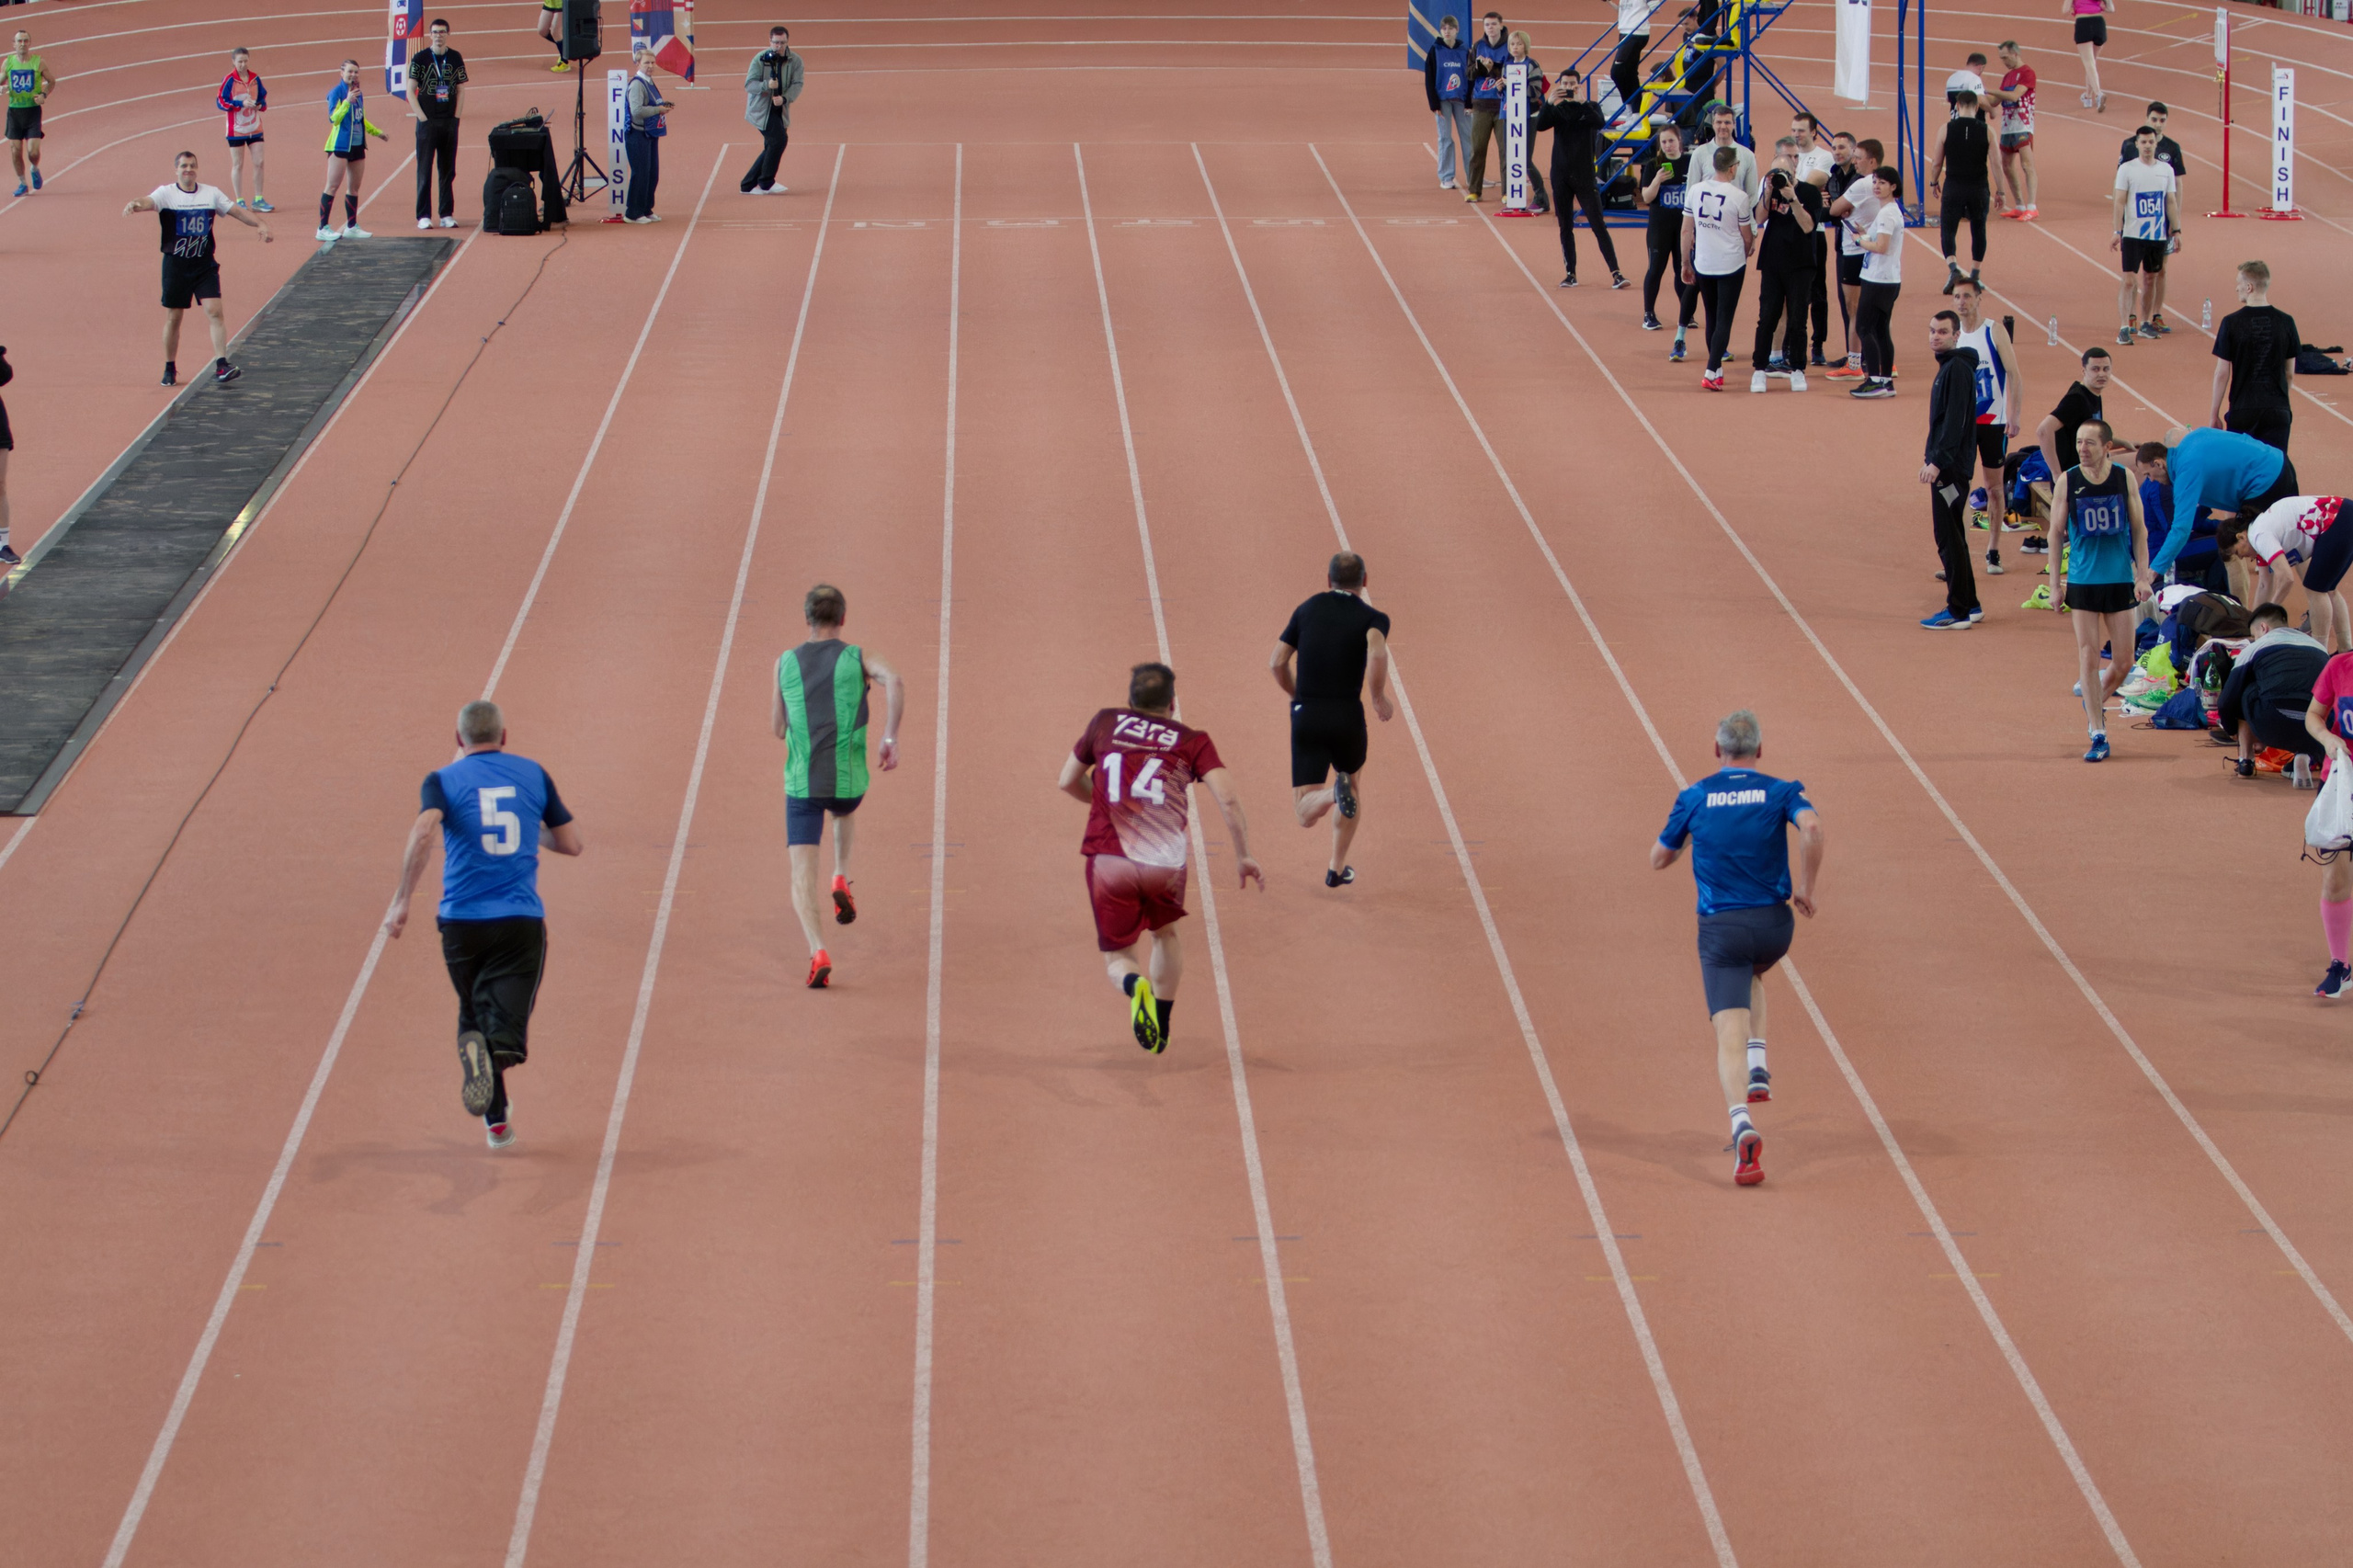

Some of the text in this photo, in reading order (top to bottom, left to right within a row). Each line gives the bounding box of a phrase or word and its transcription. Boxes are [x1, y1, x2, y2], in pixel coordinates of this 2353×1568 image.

[13, 74, 32, 88] 244
[611, 87, 624, 205] FINISH
[1510, 82, 1523, 199] FINISH
[2277, 85, 2290, 202] FINISH
[1663, 190, 1686, 206] 050
[2139, 198, 2162, 215] 054
[180, 215, 205, 233] 146
[2084, 506, 2120, 532] 091
[1103, 752, 1165, 805] 14
[478, 785, 521, 856] 5
